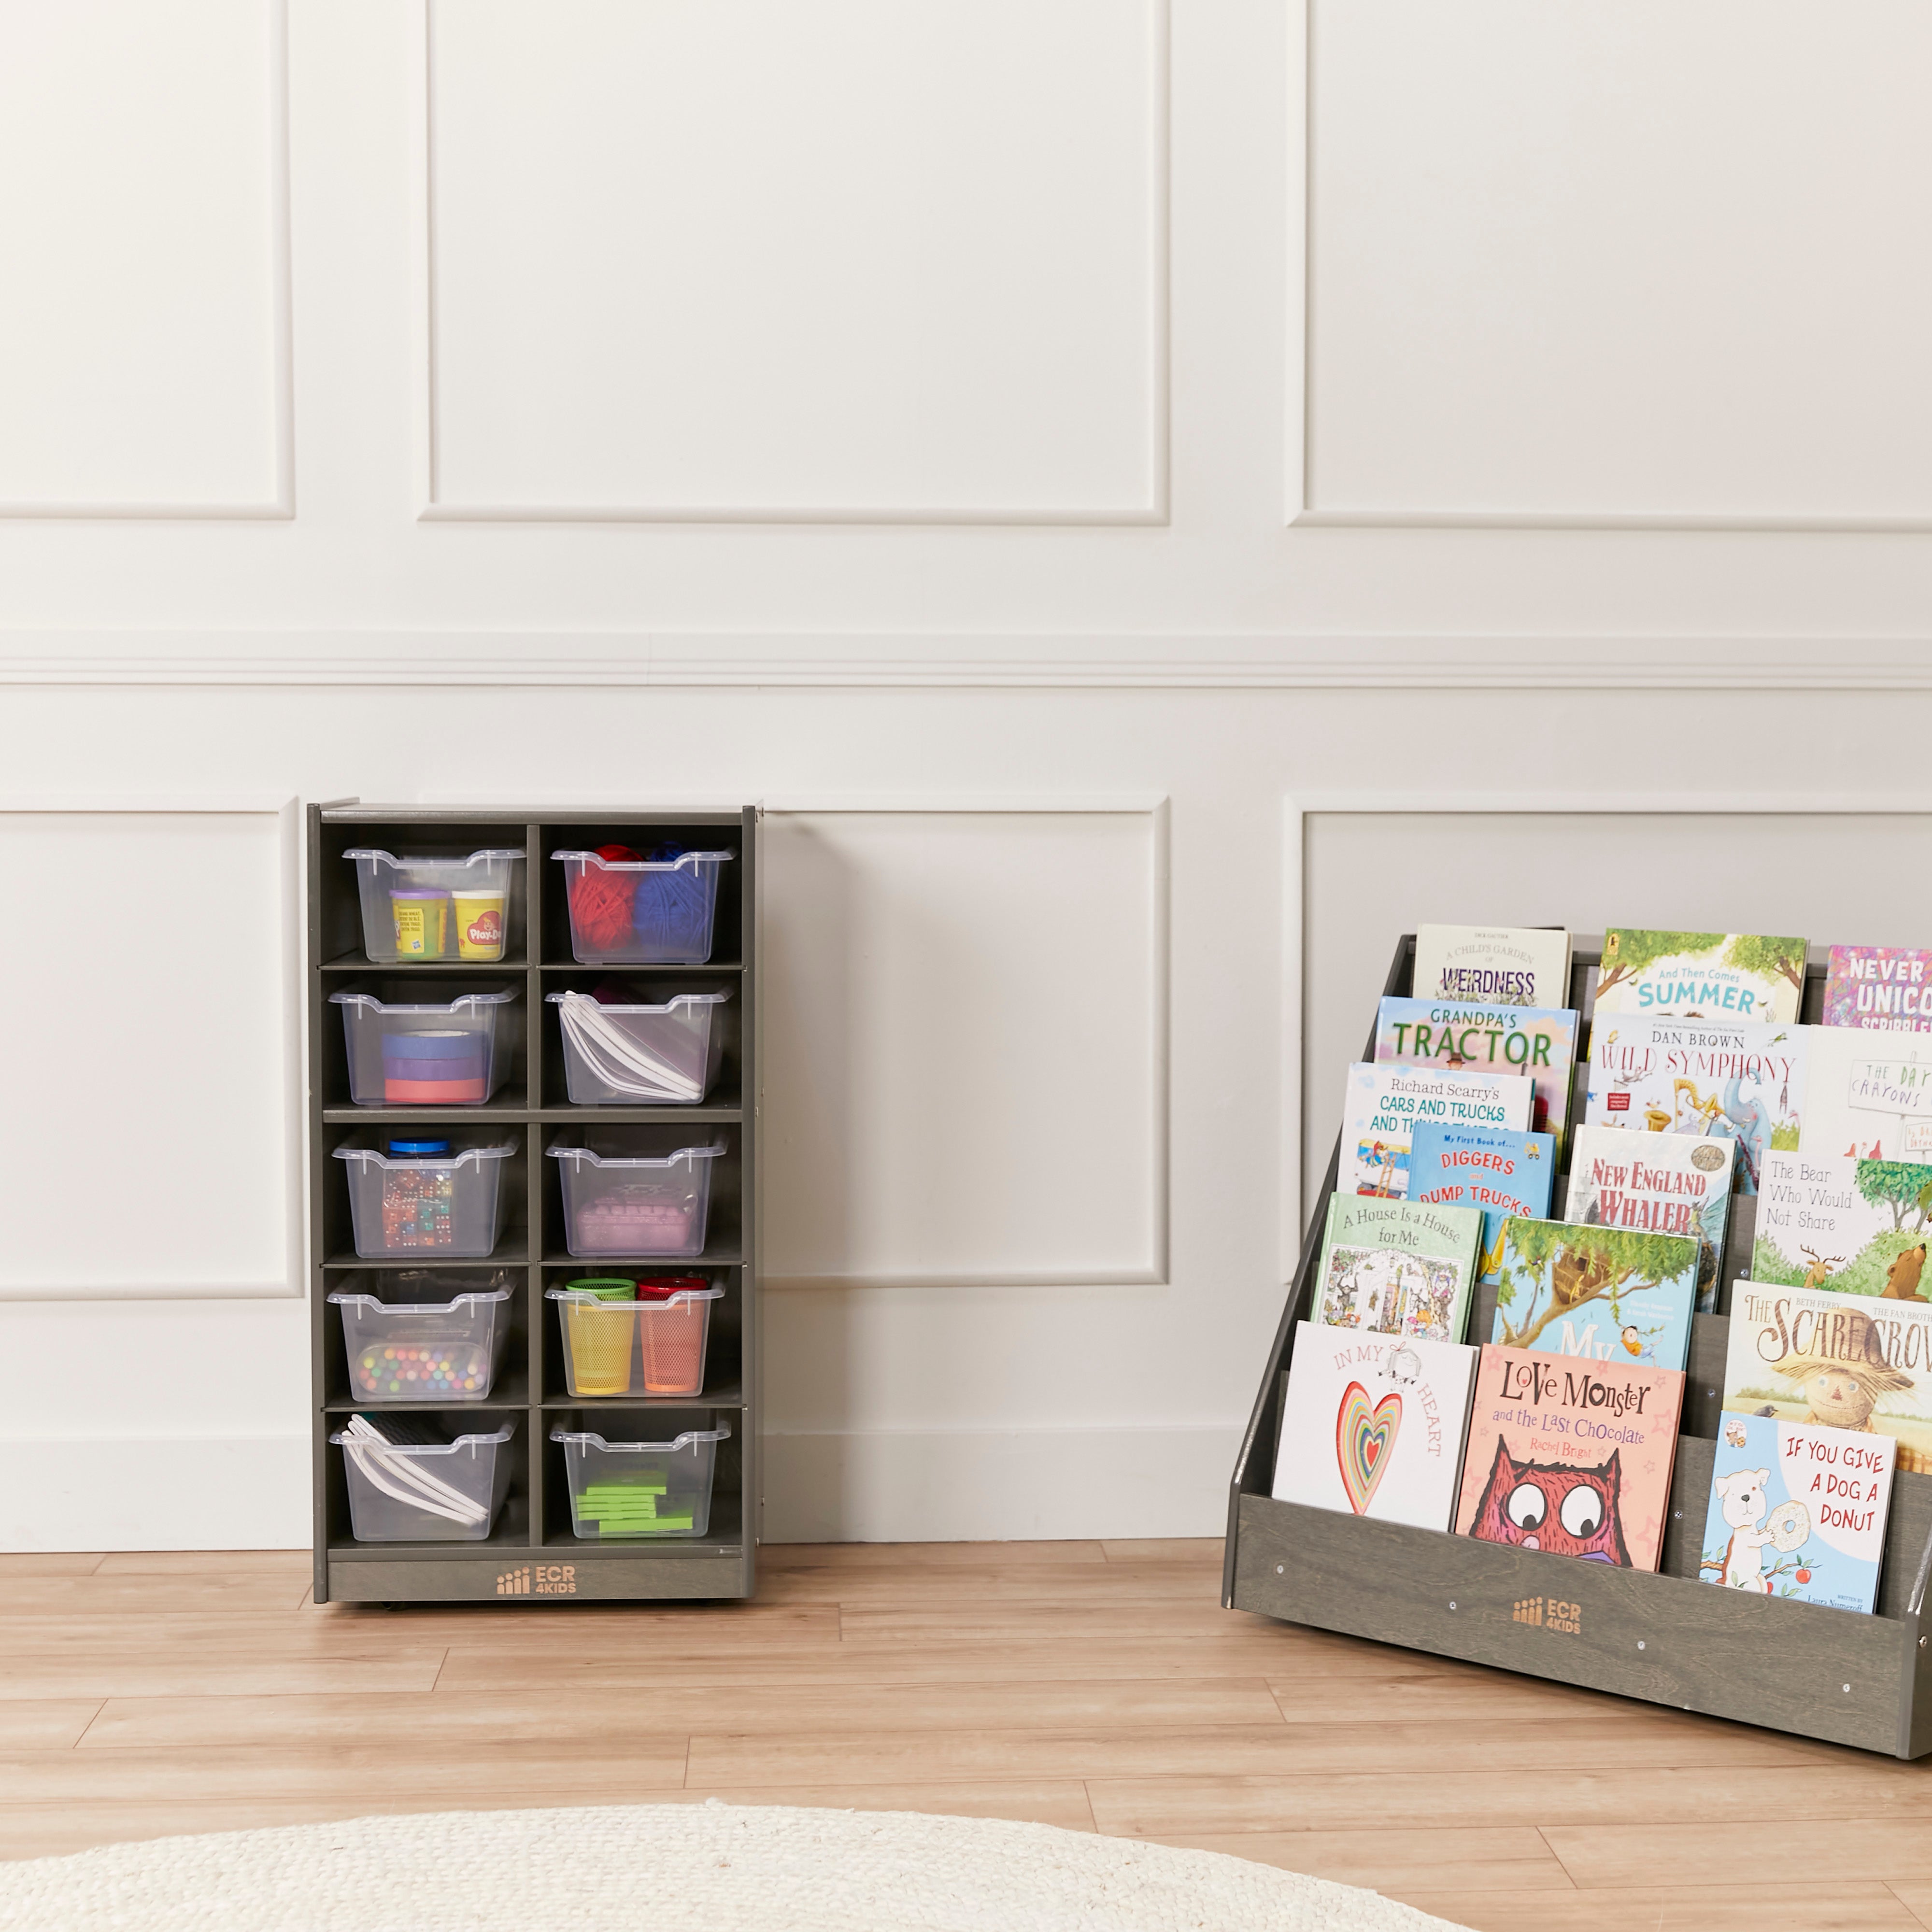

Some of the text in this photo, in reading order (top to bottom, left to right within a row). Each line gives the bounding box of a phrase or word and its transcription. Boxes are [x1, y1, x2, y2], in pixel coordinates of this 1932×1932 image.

[1447, 944, 1534, 964] A CHILD'S GARDEN
[1443, 967, 1535, 995] WEIRDNESS
[1659, 968, 1740, 982] And Then Comes
[1849, 957, 1924, 982] NEVER
[1638, 982, 1755, 1014] SUMMER
[1431, 1009, 1517, 1028] GRANDPA'S
[1393, 1023, 1551, 1066] TRACTOR
[1652, 1031, 1745, 1049] DAN BROWN
[1602, 1044, 1797, 1083] WILD SYMPHONY
[1866, 1065, 1931, 1087] THE DAY
[1391, 1078, 1500, 1101] Richard Scarry's
[1851, 1079, 1920, 1107] CRAYONS
[1380, 1095, 1505, 1122] CARS AND TRUCKS
[1370, 1115, 1397, 1132] AND
[1444, 1135, 1454, 1143] My
[1477, 1137, 1495, 1146] Book
[1441, 1150, 1516, 1176] DIGGERS
[1772, 1161, 1832, 1182] The Bear
[1469, 1172, 1484, 1180] and
[1591, 1158, 1706, 1196] NEW ENGLAND
[1420, 1185, 1532, 1217] DUMP TRUCKS
[1770, 1184, 1853, 1208] Who Would
[1600, 1189, 1691, 1234] WHALER
[1767, 1208, 1836, 1231] Not Share
[1343, 1207, 1461, 1244] A House Is a House
[1378, 1227, 1420, 1246] for Me
[1796, 1297, 1816, 1307] BETH
[1818, 1299, 1841, 1309] FERRY
[1873, 1307, 1889, 1316] THE
[1890, 1310, 1906, 1318] FAN
[1333, 1345, 1442, 1457] IN MY HEART
[1493, 1409, 1513, 1421] and
[1517, 1409, 1537, 1428] the
[1575, 1419, 1645, 1444] Chocolate
[1530, 1437, 1592, 1459] Rachel Bright
[1786, 1436, 1884, 1474] IF YOU GIVE
[1810, 1473, 1878, 1502] A DOG A
[1820, 1504, 1875, 1532] DONUT
[536, 1565, 576, 1582] ECR
[535, 1582, 576, 1594] 4KIDS
[1547, 1599, 1582, 1622] ECR
[1546, 1617, 1581, 1634] 4KIDS
